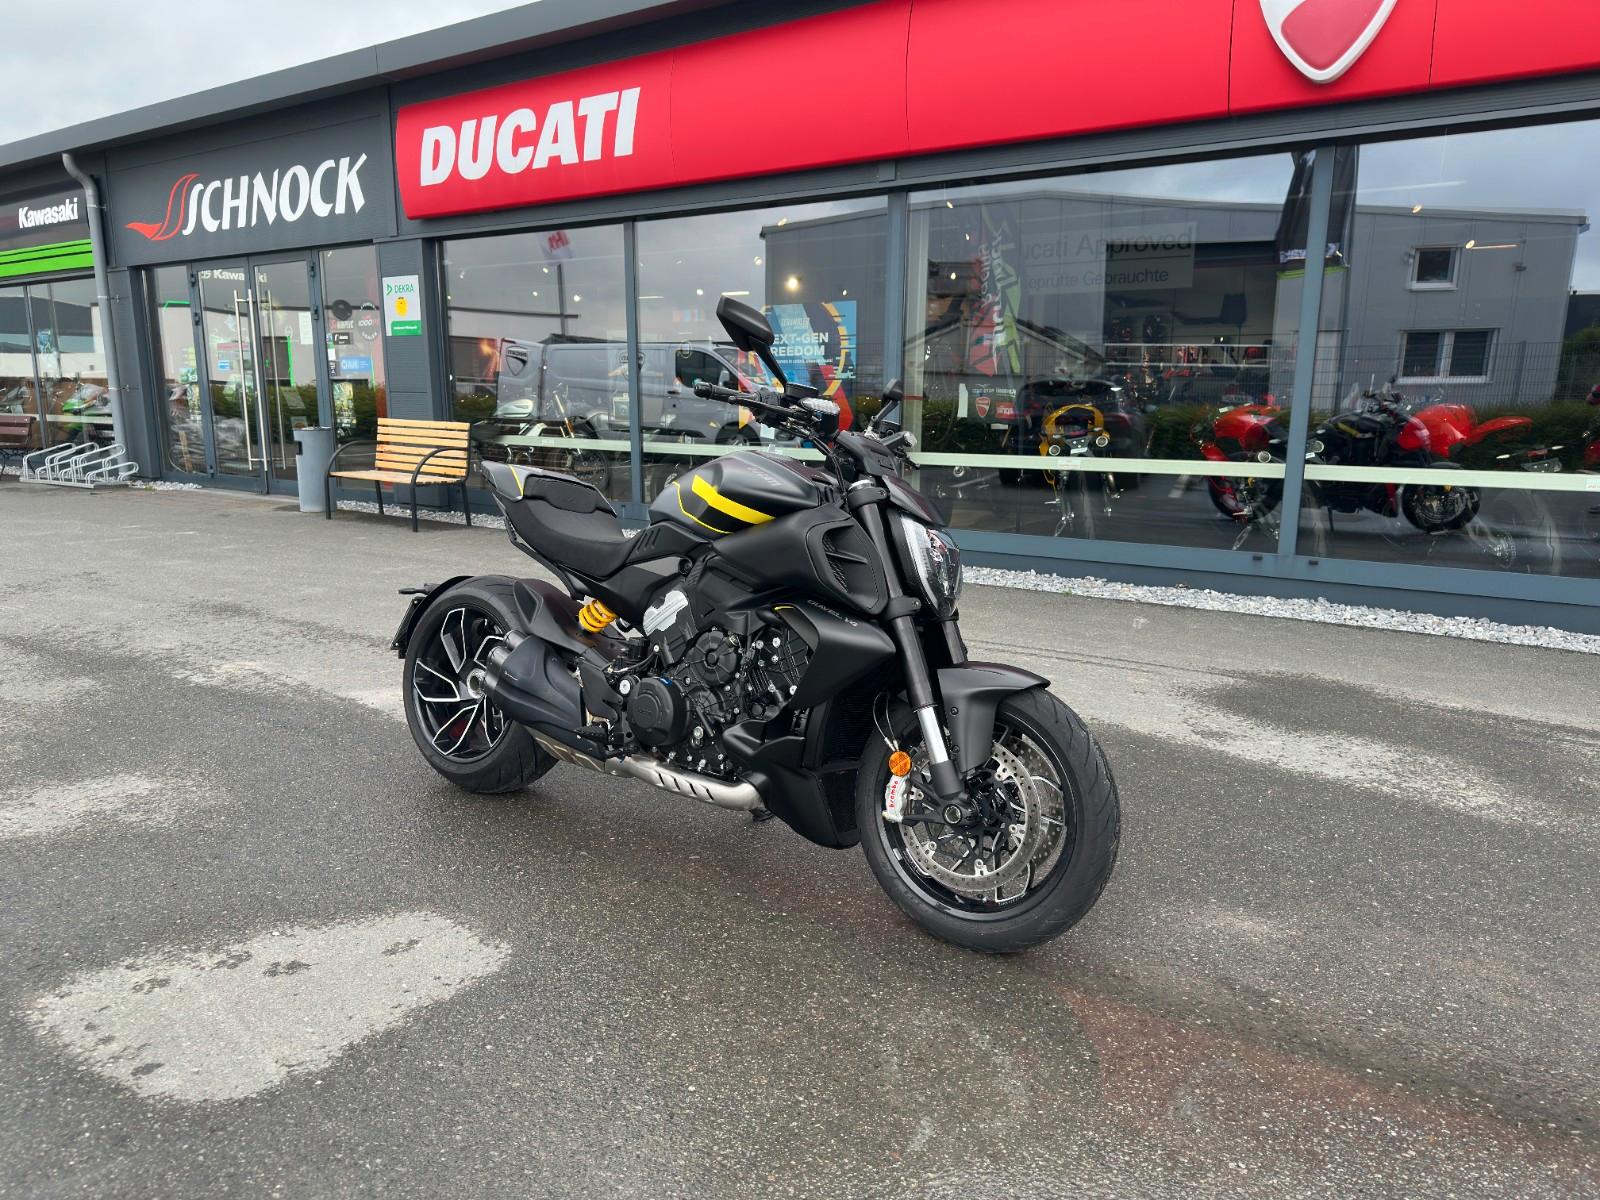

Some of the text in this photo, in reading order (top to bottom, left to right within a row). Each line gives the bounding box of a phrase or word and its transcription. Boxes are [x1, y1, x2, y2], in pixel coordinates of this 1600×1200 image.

[419, 86, 641, 187] DUCATI
[181, 153, 368, 236] SCHNOCK
[18, 197, 78, 228] Kawasaki
[1075, 226, 1193, 259] Approved
[394, 283, 415, 294] DEKRA
[1083, 268, 1169, 286] Gebrauchte
[770, 345, 825, 357] REEDOM
[773, 332, 829, 345] EXT-GEN
[889, 780, 899, 808] brembo
